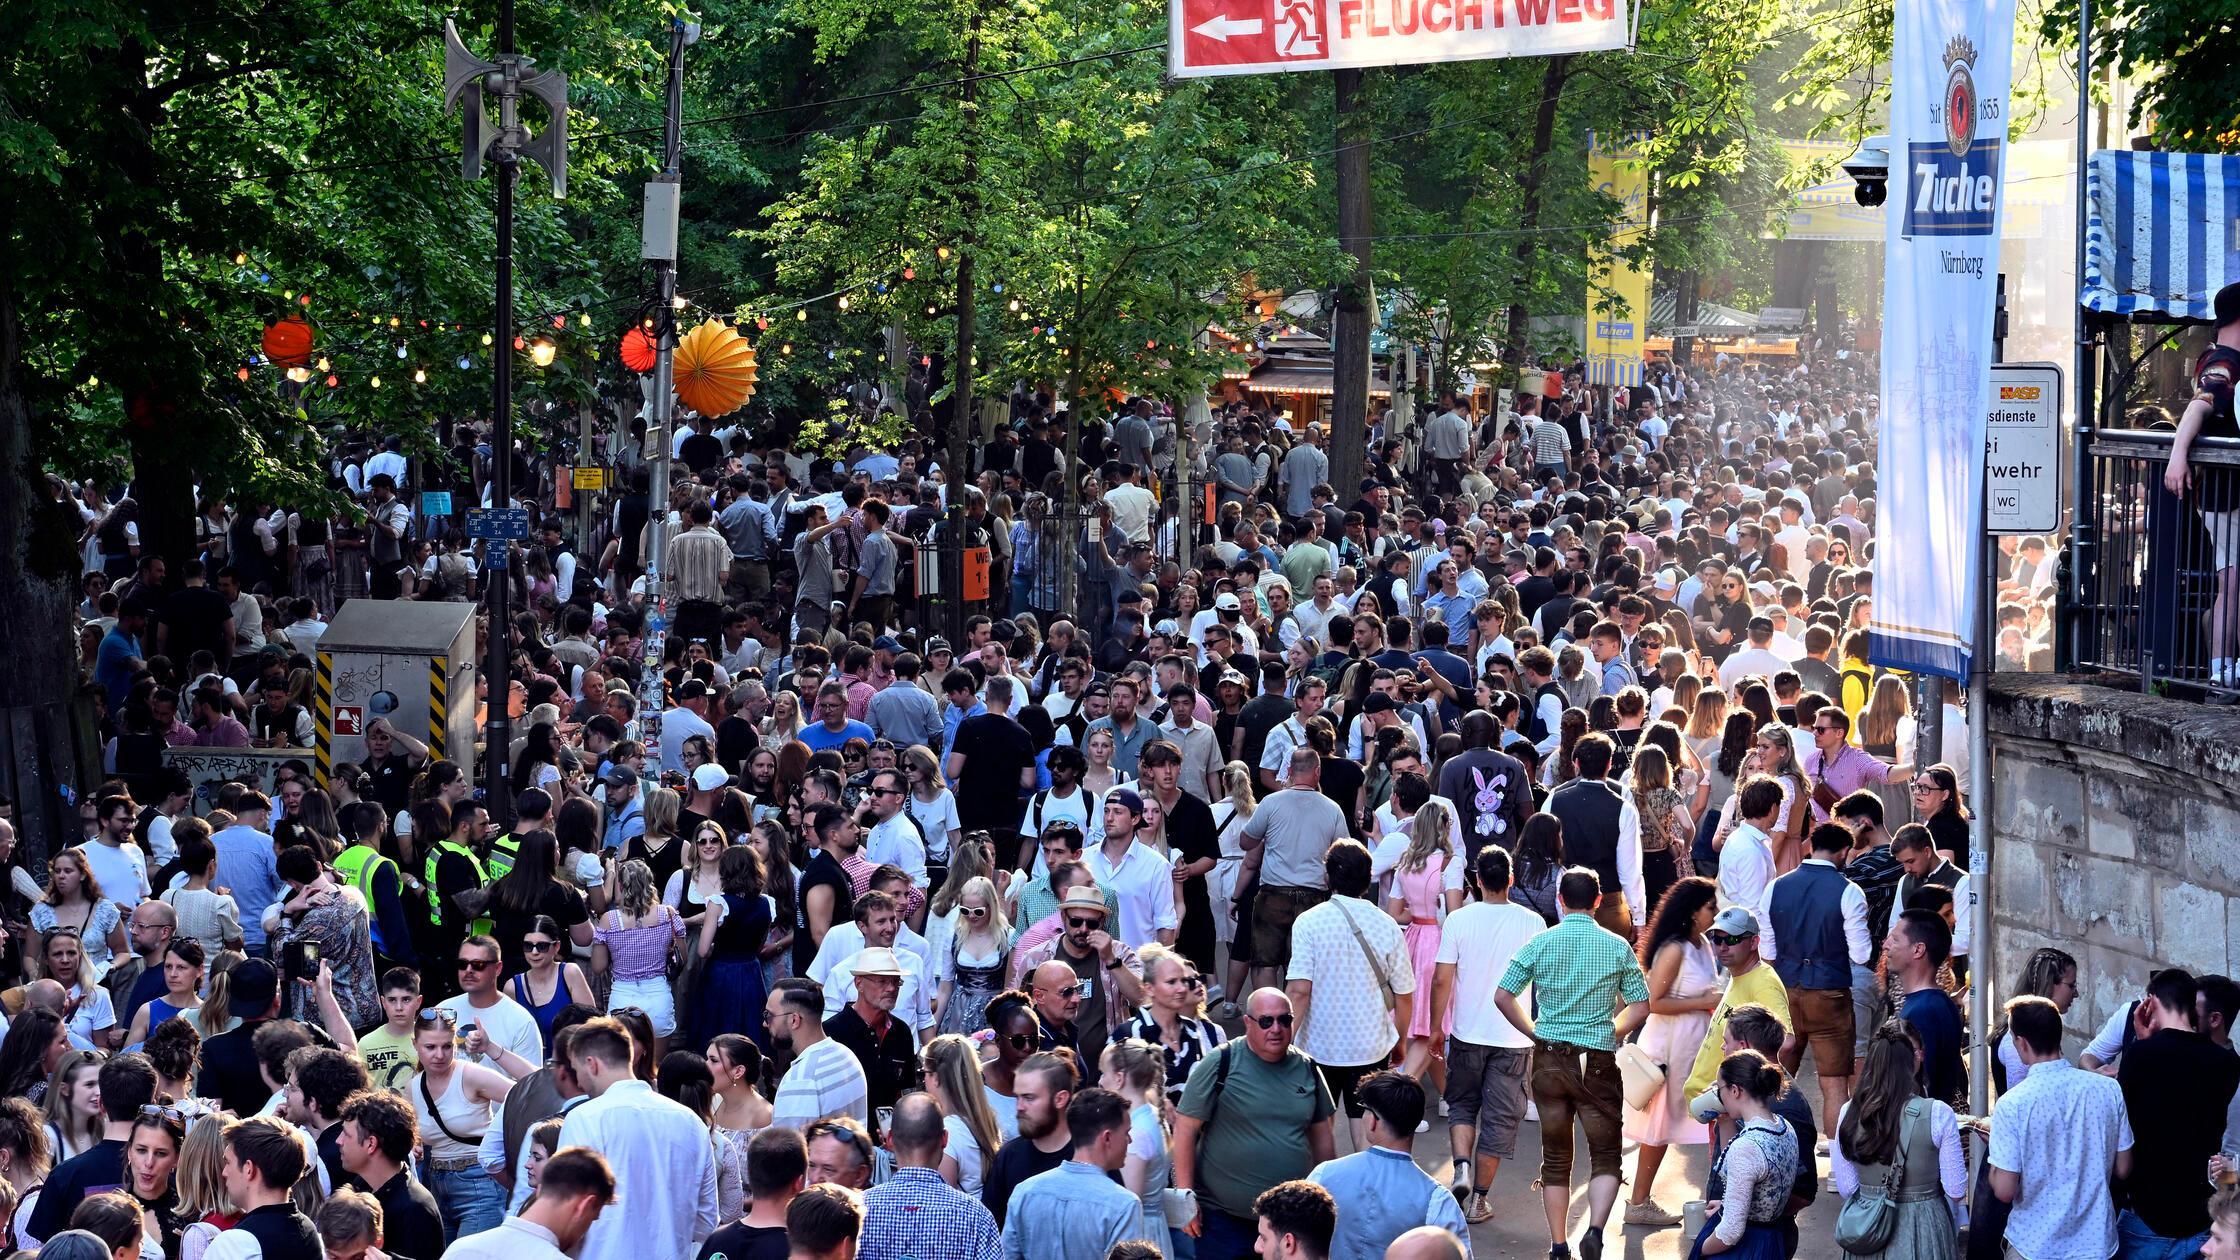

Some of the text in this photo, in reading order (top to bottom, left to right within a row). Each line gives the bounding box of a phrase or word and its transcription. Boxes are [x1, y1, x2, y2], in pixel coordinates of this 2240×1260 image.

[1339, 0, 1616, 39] FLUCHTWEG
[1979, 98, 2000, 120] 1855
[1914, 163, 1997, 214] Tuche
[1940, 249, 1984, 280] Nürnberg
[1599, 325, 1630, 336] Tuher
[2013, 386, 2041, 400] ASB
[1997, 496, 2016, 507] WC
[366, 1052, 398, 1062] SKATE
[368, 1062, 387, 1071] LIFE
